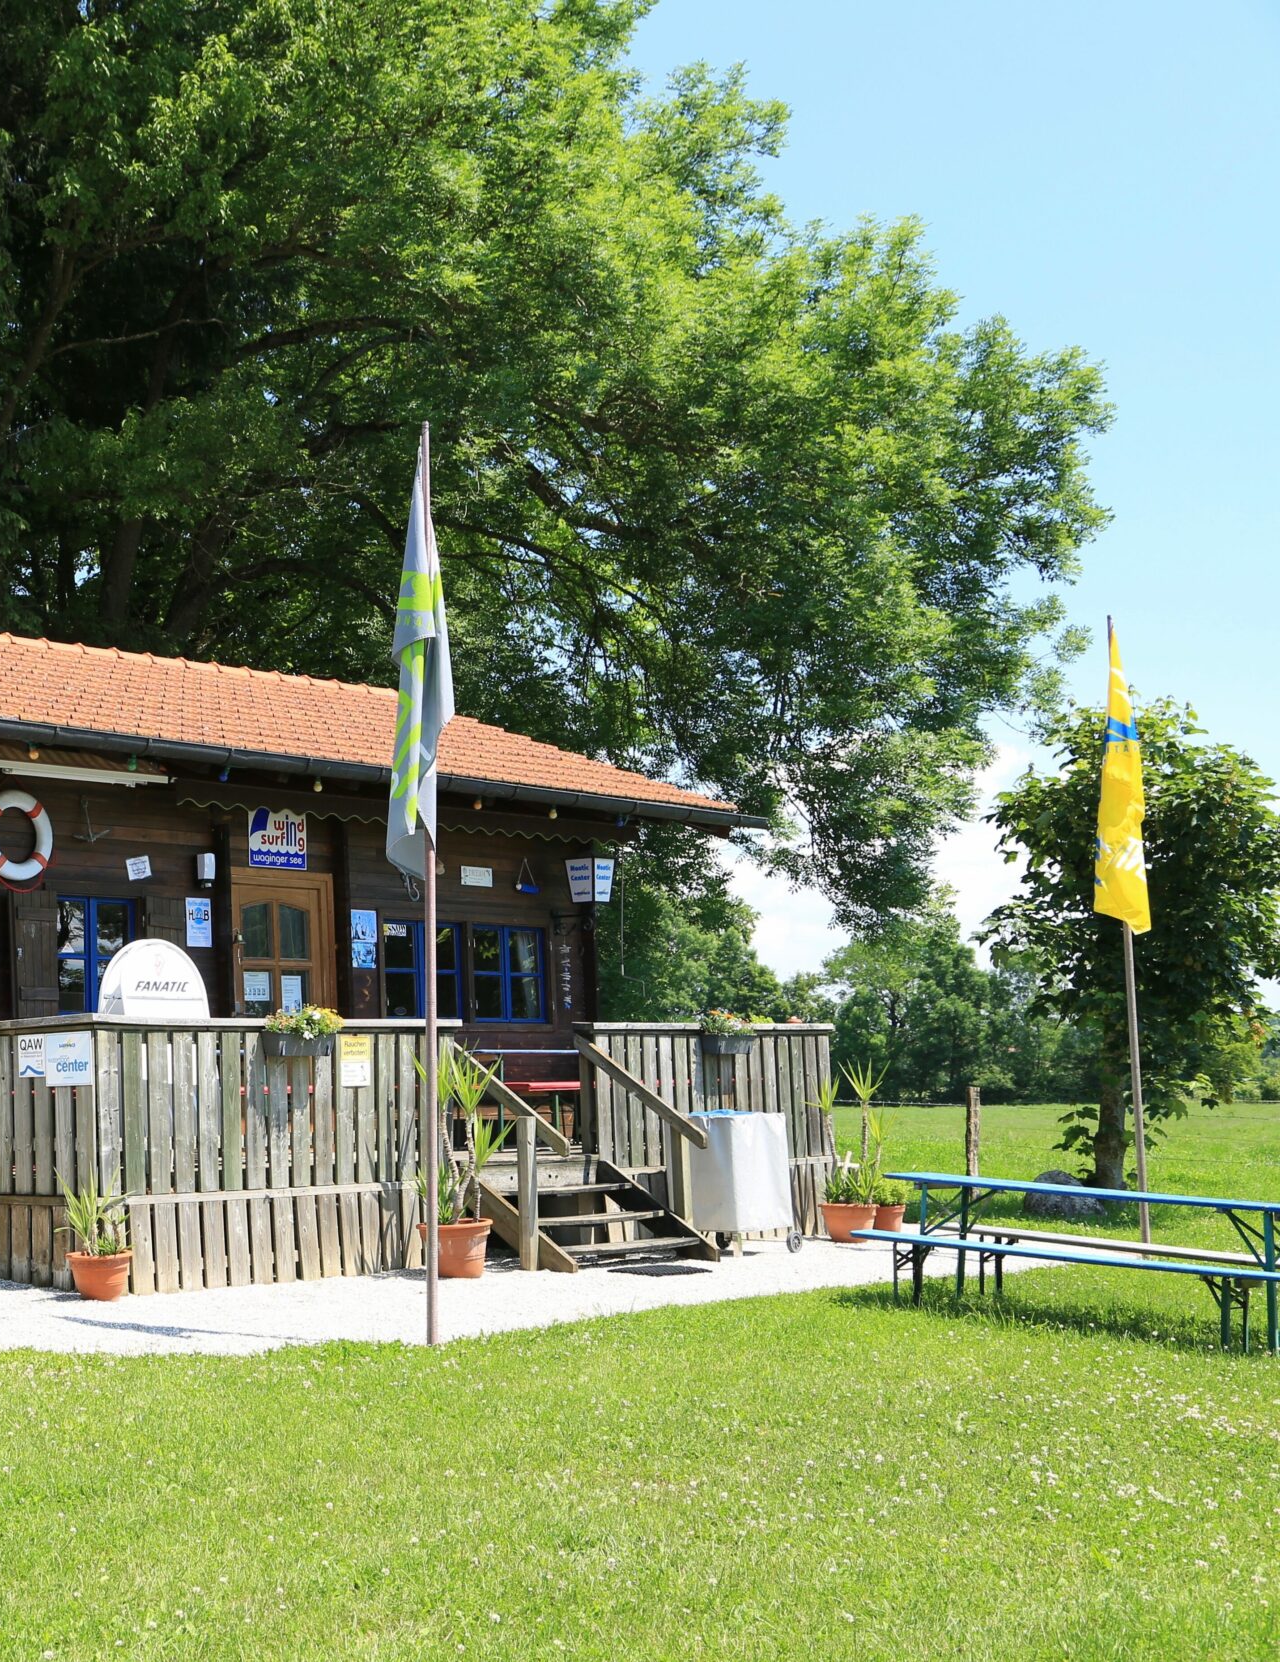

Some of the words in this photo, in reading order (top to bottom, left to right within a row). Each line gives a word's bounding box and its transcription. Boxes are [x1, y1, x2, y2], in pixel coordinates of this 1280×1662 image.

[261, 823, 305, 852] surfing
[253, 853, 289, 866] waginger
[290, 857, 303, 865] see
[135, 981, 188, 992] FANATIC
[20, 1038, 43, 1050] QAW
[344, 1040, 367, 1048] Rauchen
[56, 1059, 89, 1072] center
